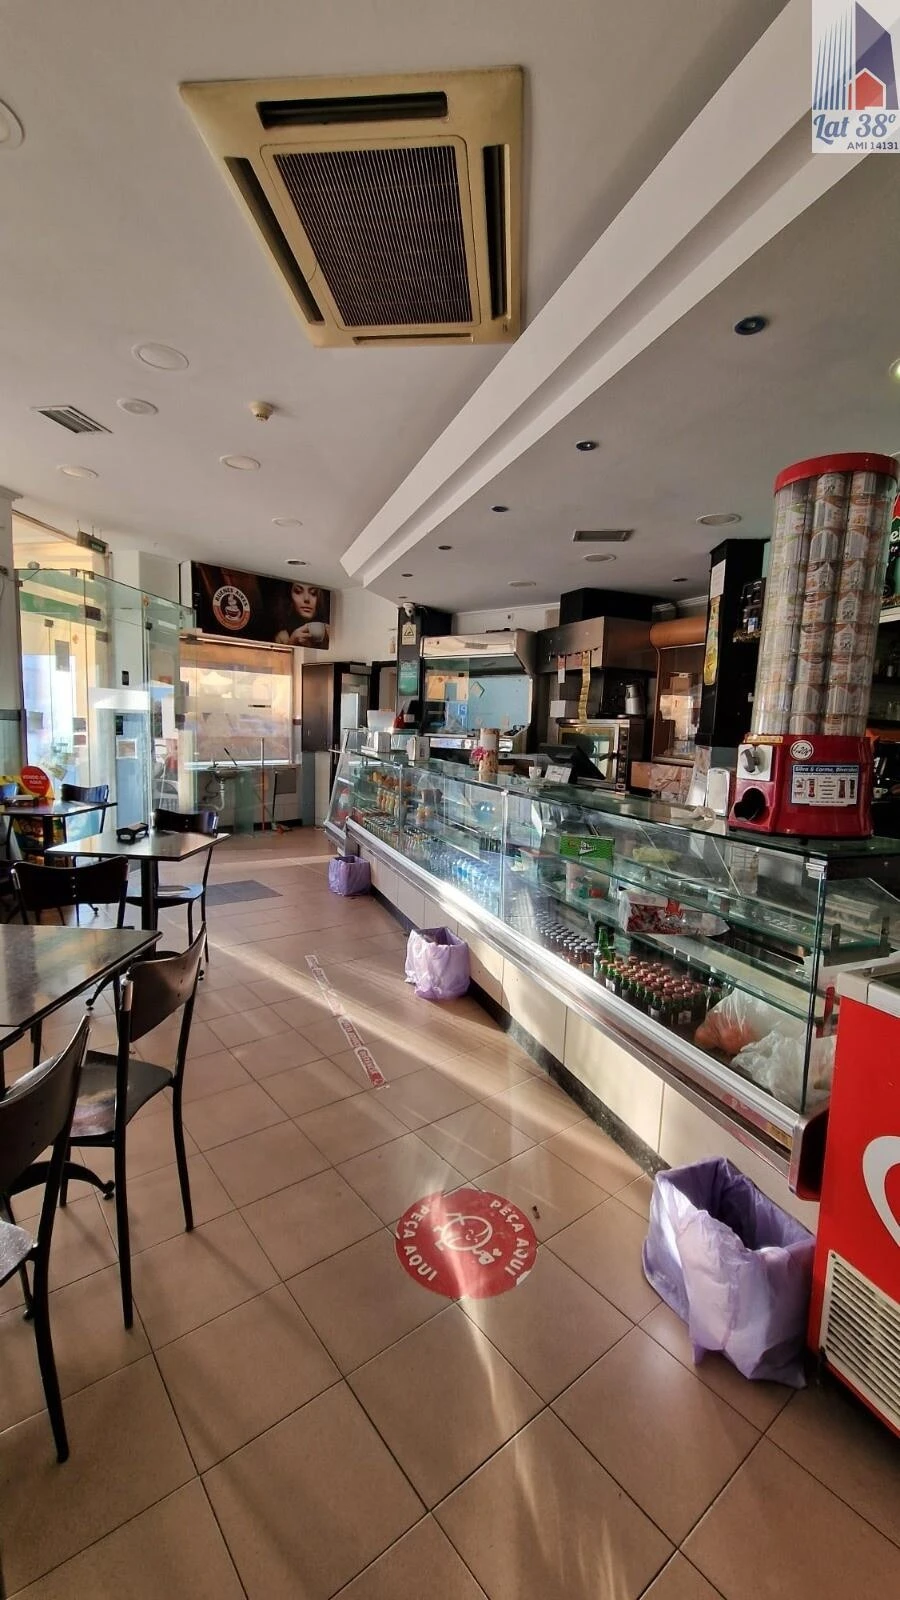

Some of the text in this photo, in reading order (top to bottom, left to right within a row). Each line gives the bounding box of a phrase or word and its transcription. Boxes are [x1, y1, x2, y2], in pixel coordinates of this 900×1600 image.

[403, 1245, 438, 1281] AQUI
[490, 1199, 530, 1277] PEÇA AQUI
